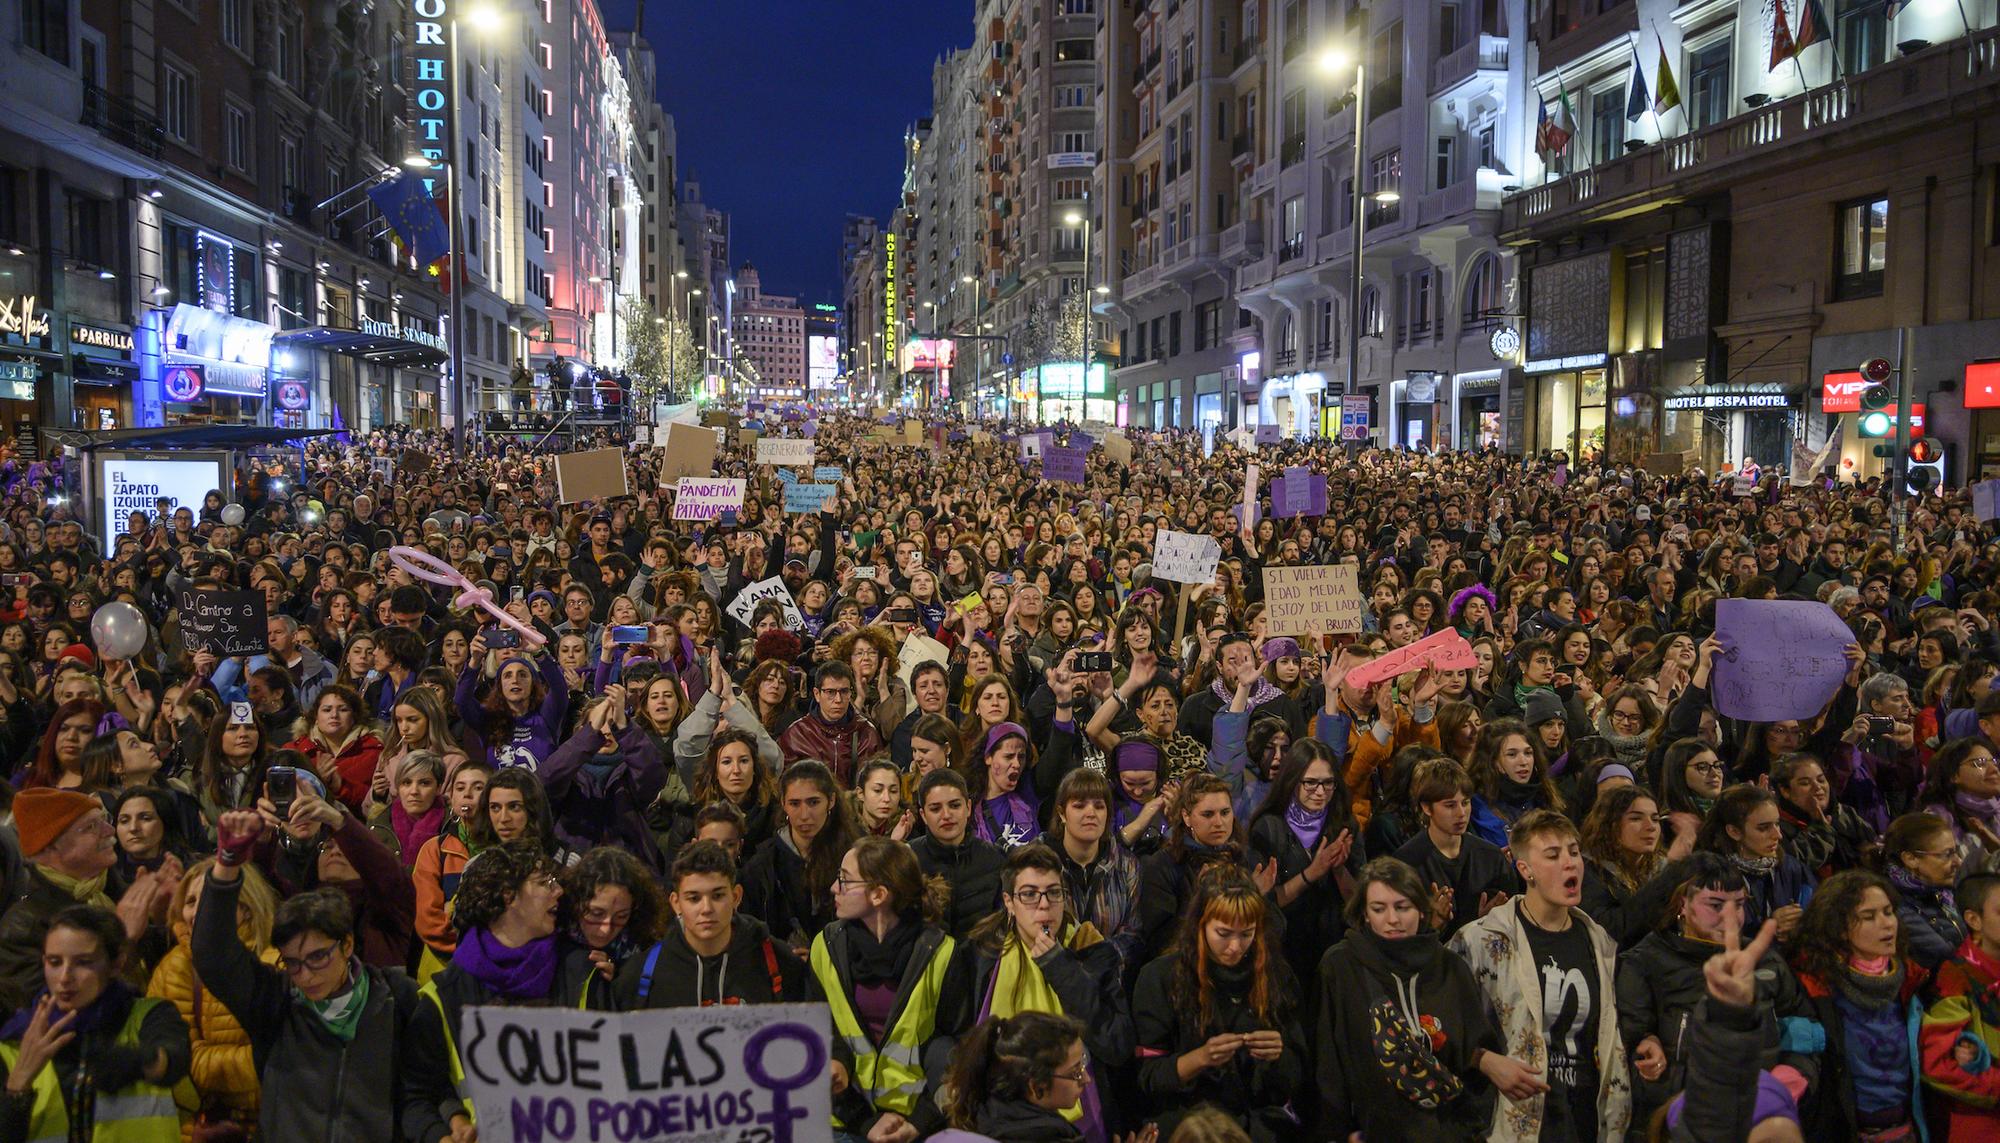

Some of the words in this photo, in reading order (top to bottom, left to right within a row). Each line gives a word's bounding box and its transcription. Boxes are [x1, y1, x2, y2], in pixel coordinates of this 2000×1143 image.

[885, 233, 895, 279] HOTEL
[885, 281, 895, 362] EMPERADOR
[80, 328, 135, 349] PARRILLA
[364, 320, 400, 339] HOTEL
[403, 326, 434, 347] SENATOR
[112, 471, 127, 483] EL
[112, 484, 159, 496] ZAPATO
[113, 496, 178, 508] IZQUIERO
[114, 509, 129, 520] ES
[1293, 569, 1328, 582] VUELVE
[1335, 567, 1349, 578] LA
[1271, 587, 1301, 600] EDAD
[1309, 585, 1346, 597] MEDIA
[196, 593, 233, 616] Camino
[1271, 602, 1305, 618] ESTOY
[1311, 601, 1330, 613] DEL
[1336, 599, 1360, 613] LADO
[1272, 620, 1291, 633] DE
[1295, 618, 1321, 632] LAS
[1325, 616, 1361, 631] BRUJAS
[466, 1010, 604, 1090] ¿QUÉ
[618, 1026, 726, 1092] LAS
[511, 1094, 576, 1143] NO
[587, 1088, 756, 1143] PODEMOS
